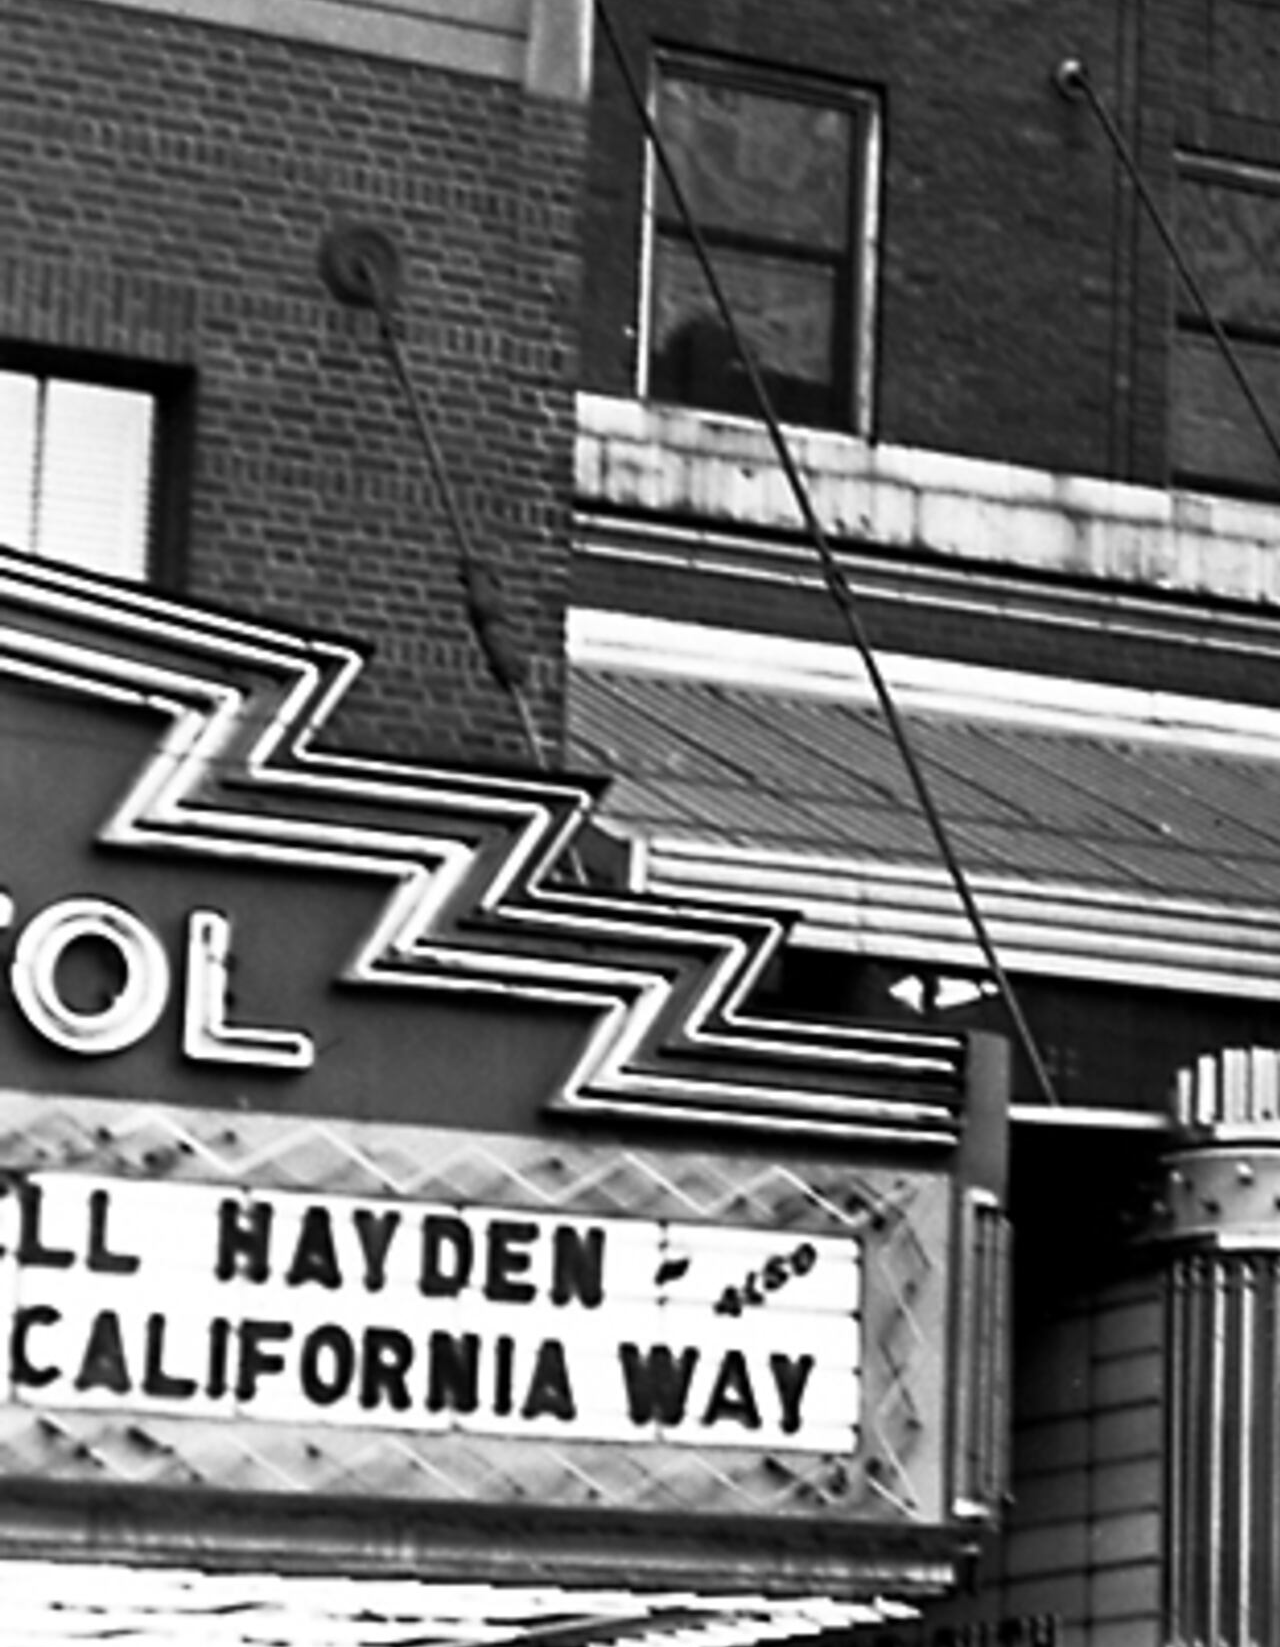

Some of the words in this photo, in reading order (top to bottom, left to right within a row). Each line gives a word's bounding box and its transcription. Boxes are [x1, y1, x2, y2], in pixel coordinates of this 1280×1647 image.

[0, 894, 314, 1067] OL
[215, 1199, 606, 1309] HAYDEN
[713, 1243, 817, 1318] ALSO
[9, 1305, 577, 1422] CALIFORNIA
[620, 1343, 814, 1434] WAY
